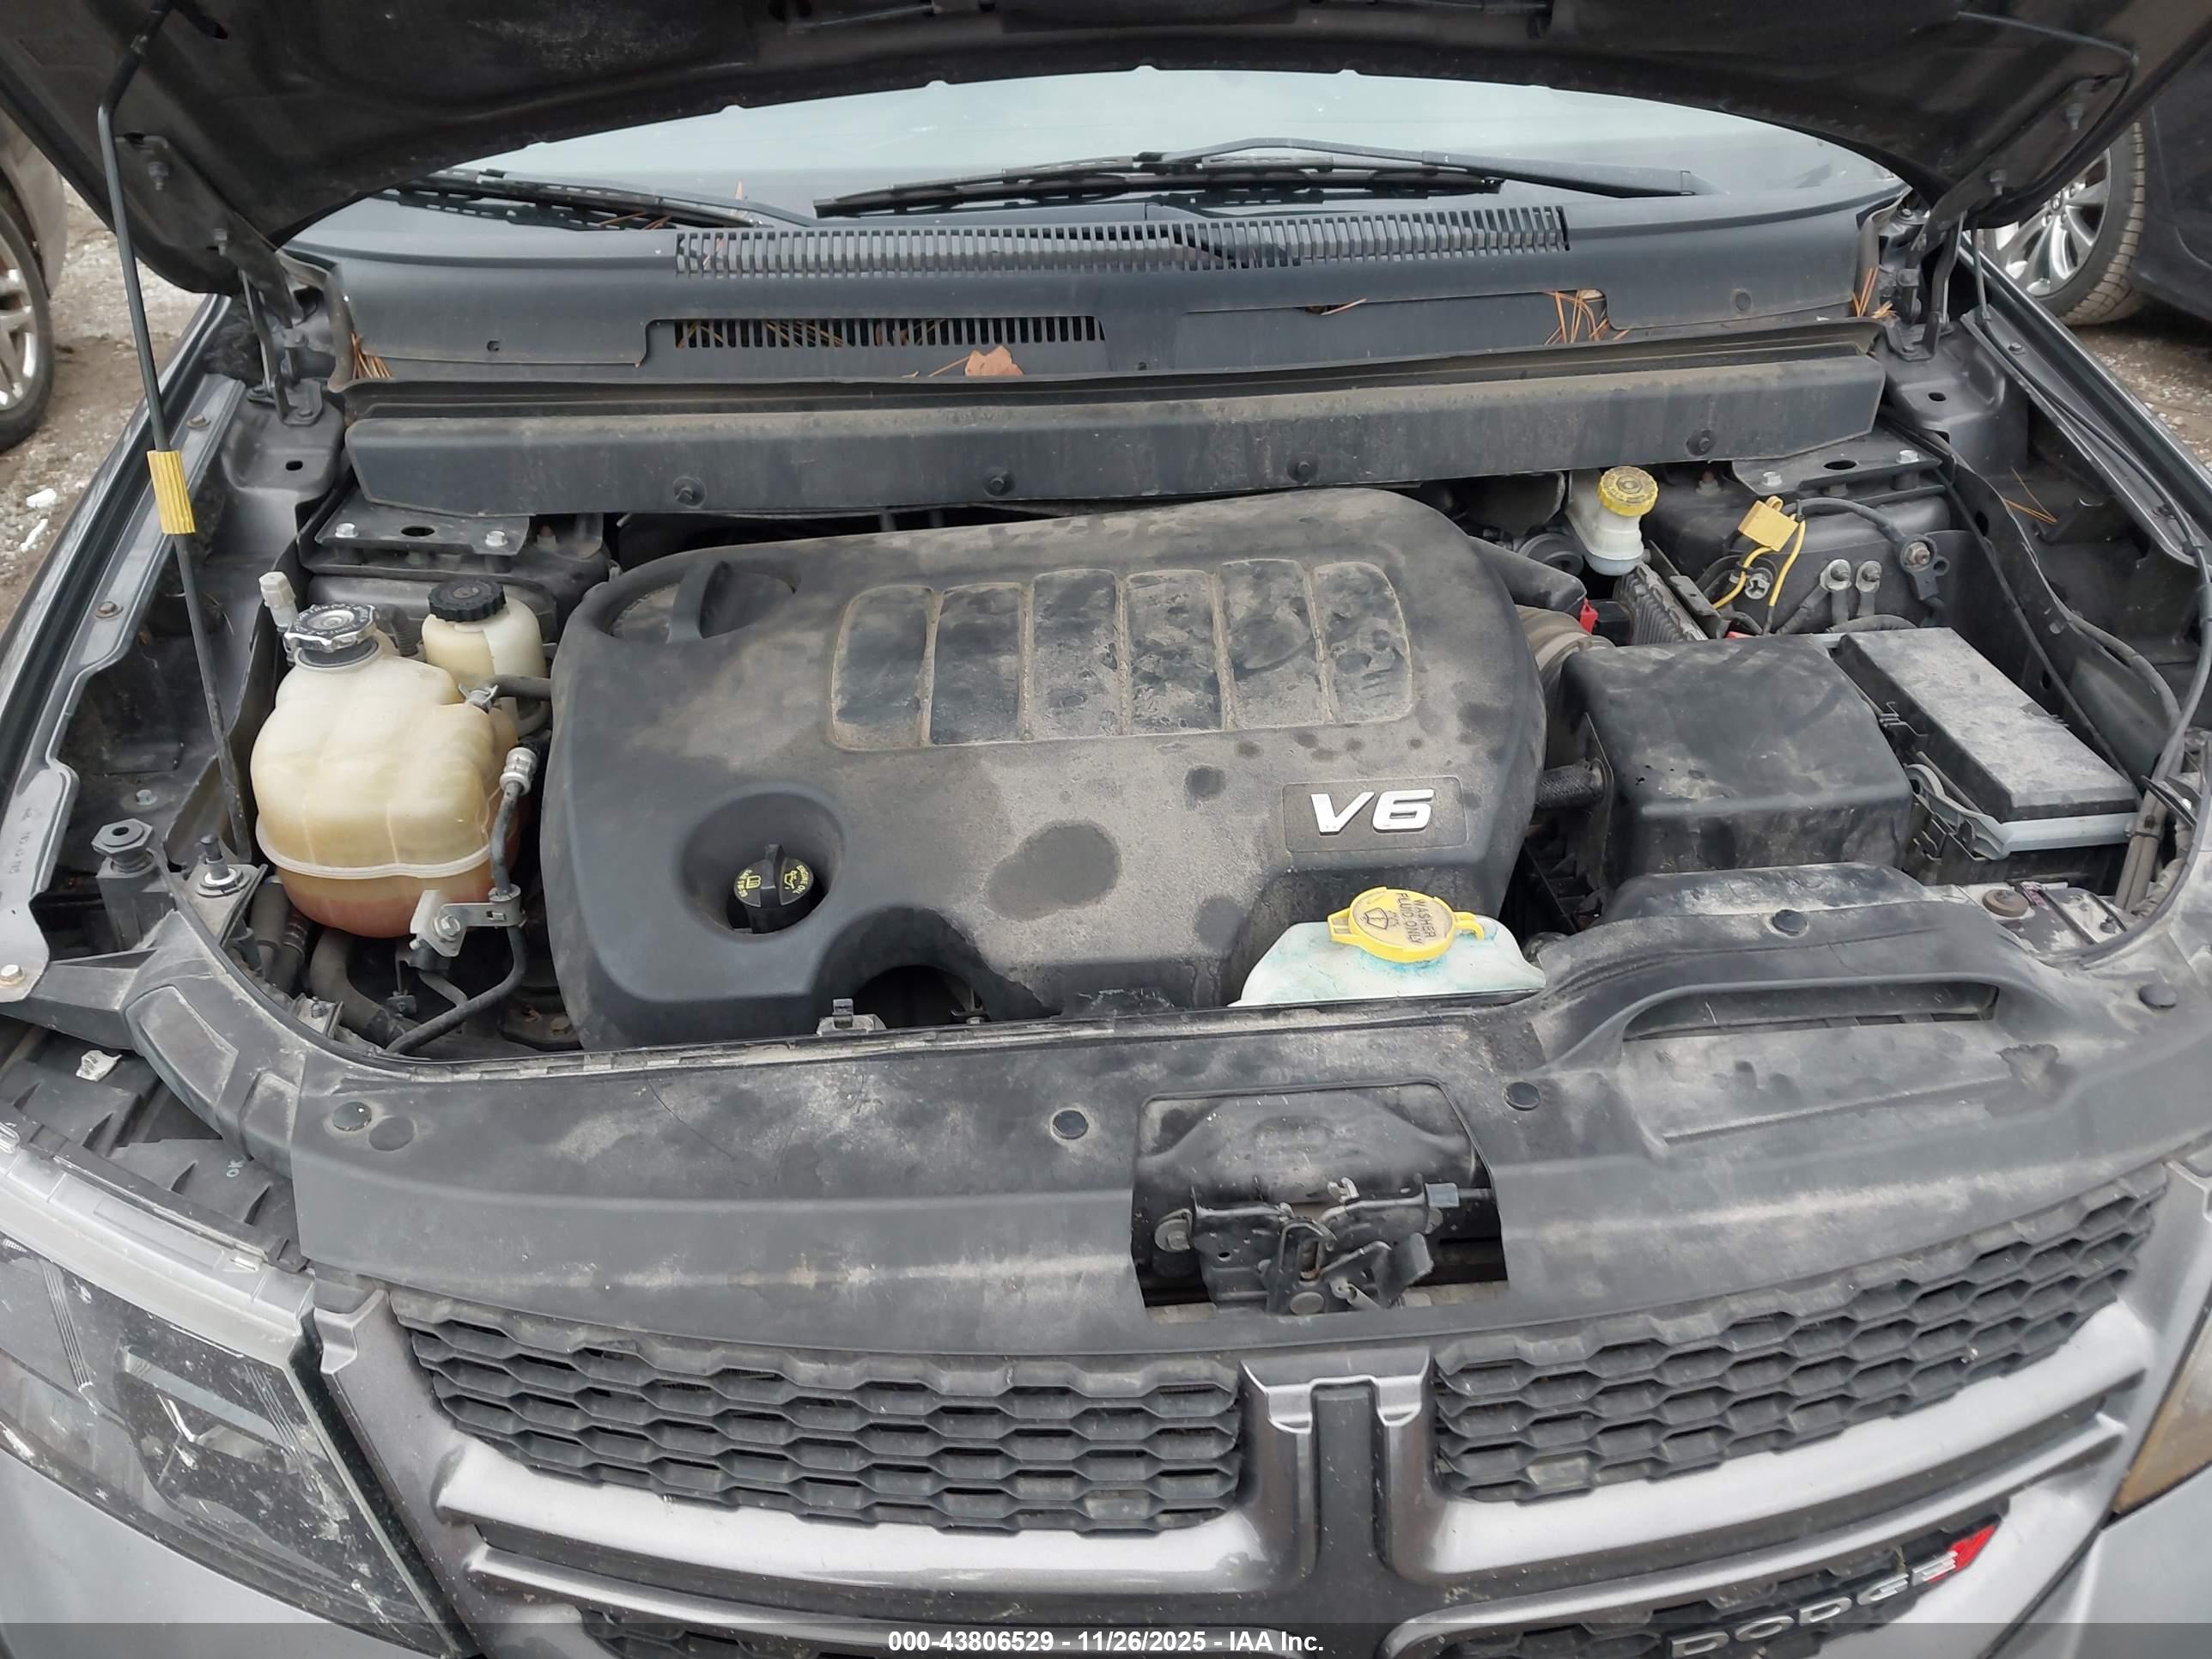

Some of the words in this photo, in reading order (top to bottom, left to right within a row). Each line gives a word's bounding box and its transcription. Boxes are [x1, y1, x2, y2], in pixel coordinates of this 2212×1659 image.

[1310, 789, 1435, 836] V6
[793, 885, 806, 895] OIL
[1397, 892, 1415, 919] FLUID
[1406, 920, 1423, 945] ONLY
[1413, 898, 1436, 938] WASHER
[1671, 1551, 1958, 1658] DODGE
